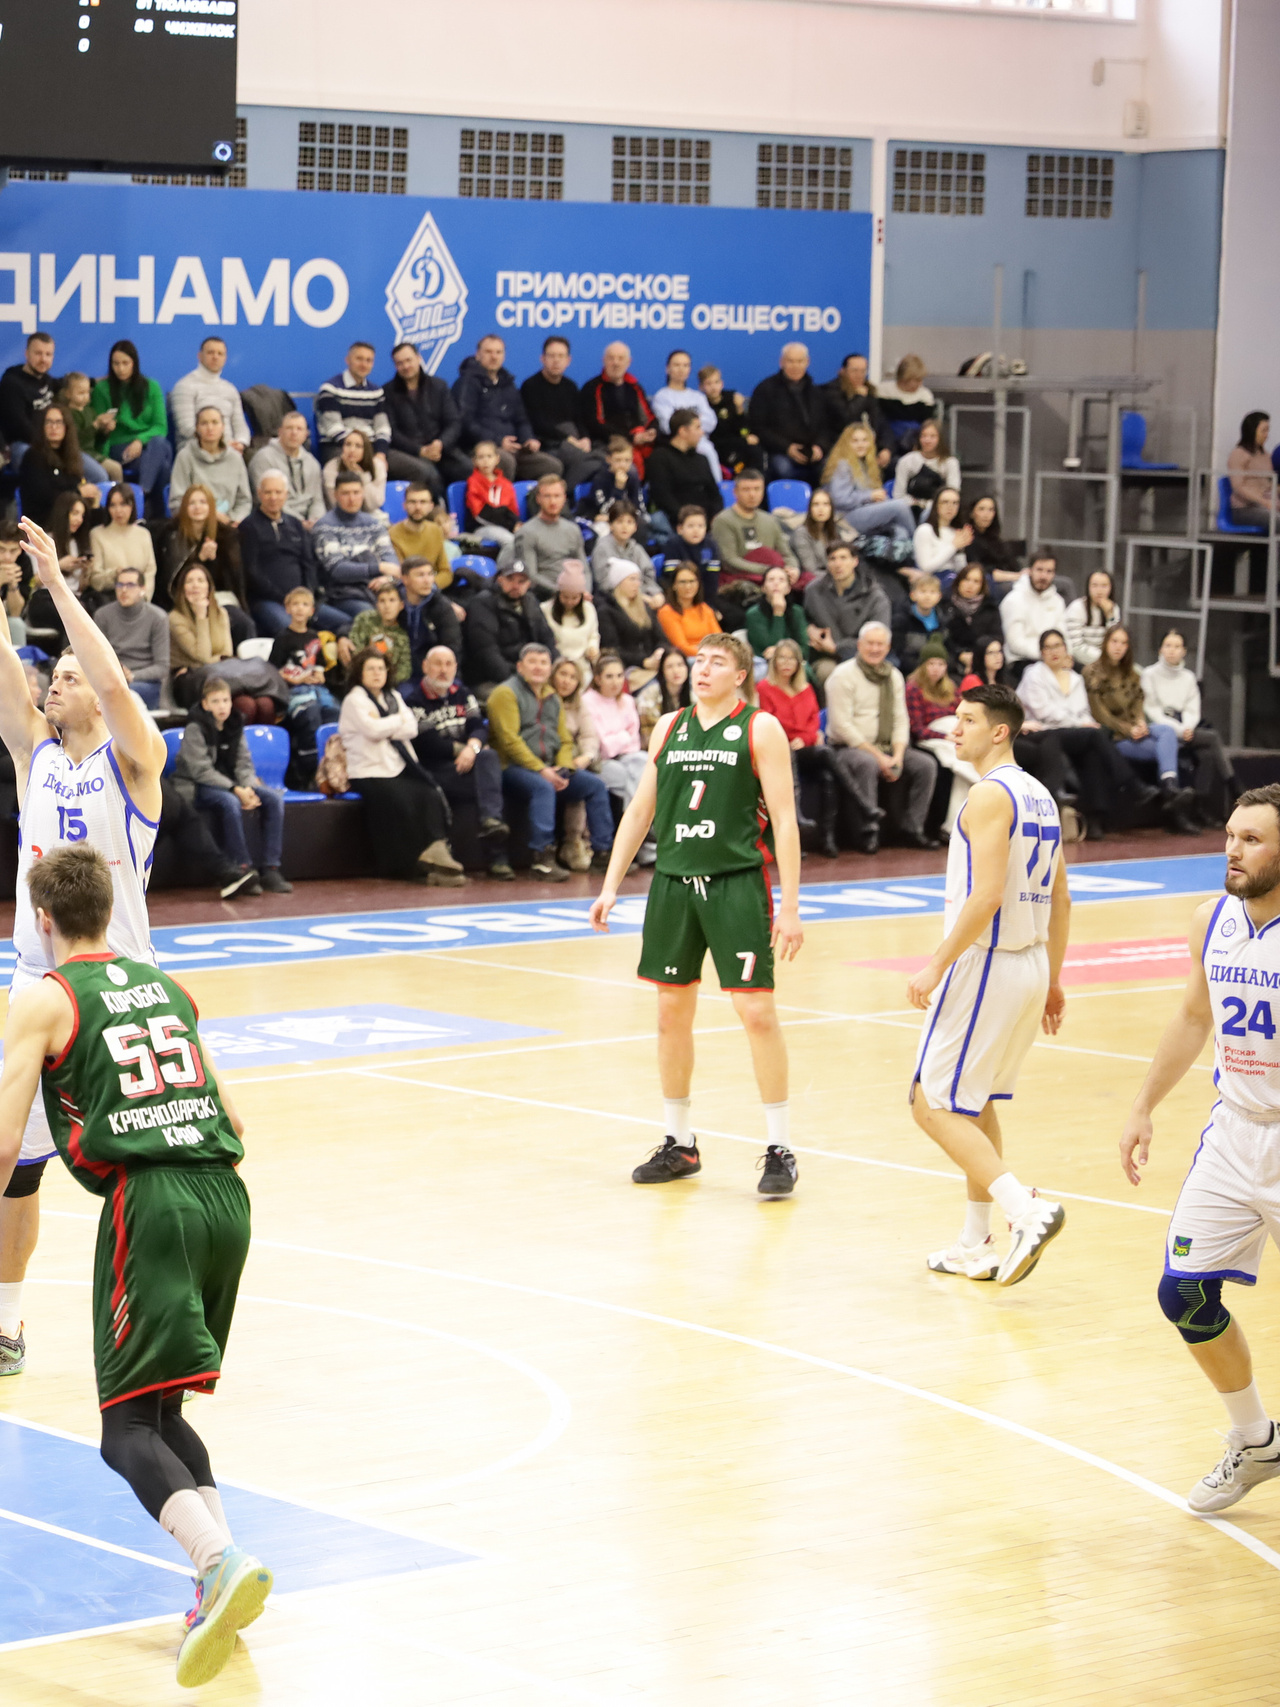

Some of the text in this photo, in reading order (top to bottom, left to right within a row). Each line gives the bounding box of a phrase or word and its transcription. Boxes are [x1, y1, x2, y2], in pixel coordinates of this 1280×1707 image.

[78, 15, 91, 29] 0
[78, 38, 91, 52] 0
[495, 270, 690, 301] ПРИМОРСКОЕ
[495, 301, 842, 334] СПОРТИВНОЕ ОБЩЕСТВО
[688, 780, 707, 811] 1
[56, 805, 88, 843] 15
[1021, 822, 1061, 888] 77
[736, 951, 757, 982] 7
[1210, 964, 1280, 989] ДИНАМ
[99, 981, 170, 1015] КОРОБКО
[1221, 996, 1276, 1040] 24
[101, 1015, 207, 1099] 55
[1224, 1045, 1257, 1057] Русская
[1225, 1065, 1266, 1077] Компания
[107, 1095, 219, 1136] КРАСНОДАРСК
[161, 1123, 205, 1148] КРАЙ
